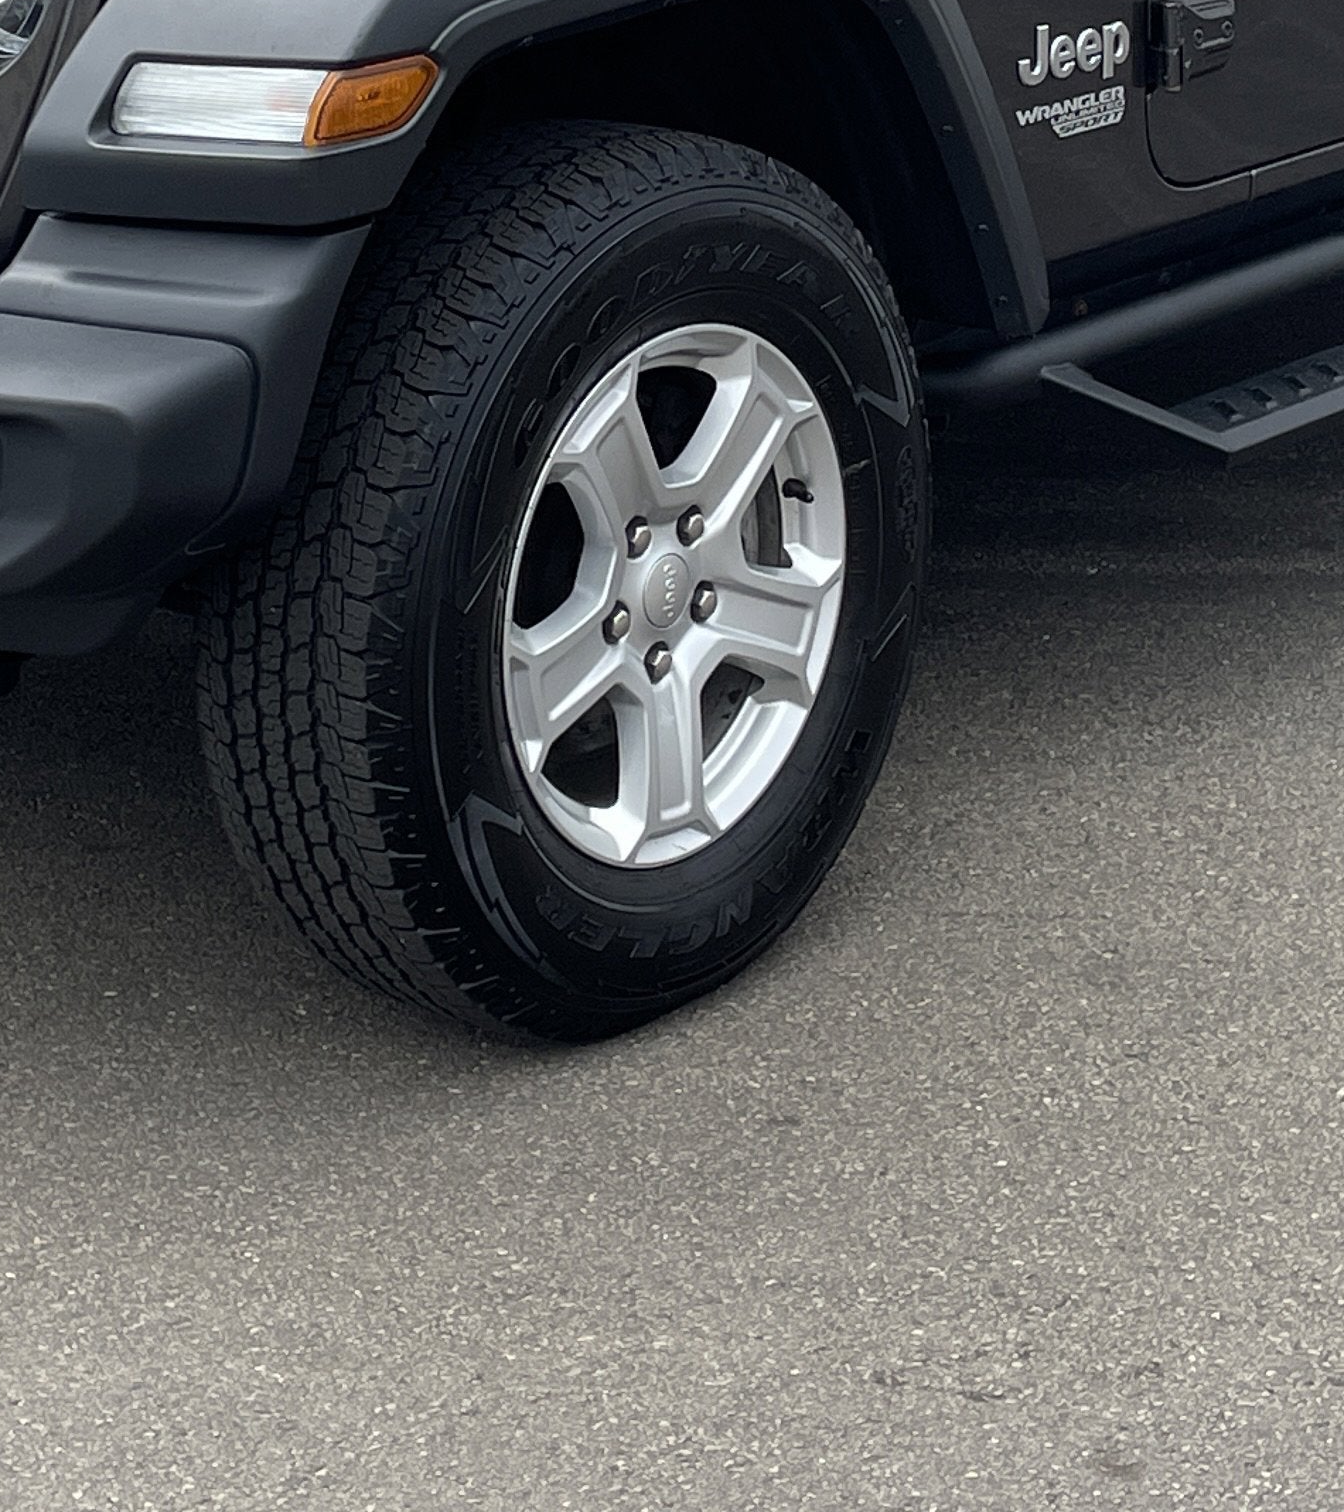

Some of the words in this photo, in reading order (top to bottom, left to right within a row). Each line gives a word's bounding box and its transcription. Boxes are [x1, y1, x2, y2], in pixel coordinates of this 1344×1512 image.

[1017, 20, 1130, 86] Jeep
[1016, 85, 1124, 126] WRANGLER
[1059, 111, 1123, 134] SPORT
